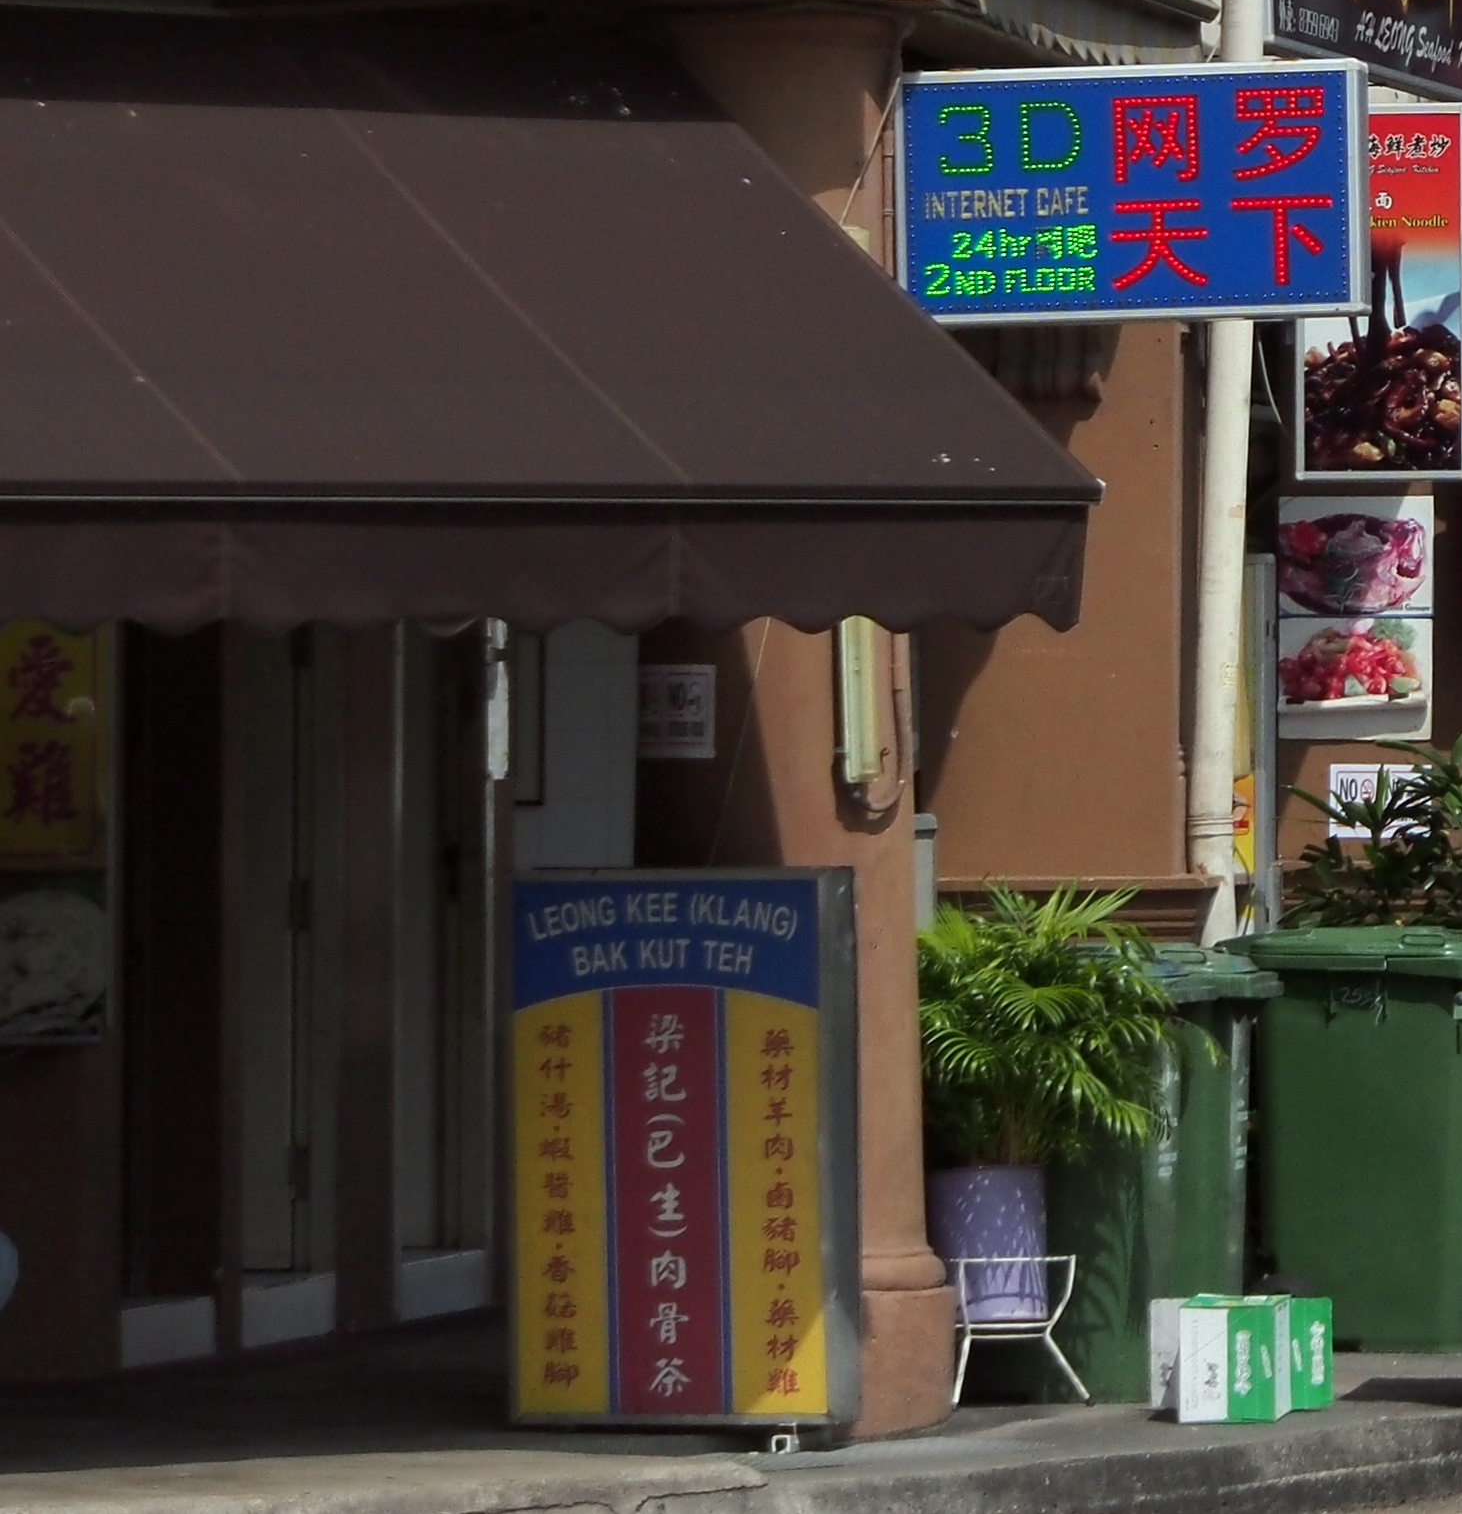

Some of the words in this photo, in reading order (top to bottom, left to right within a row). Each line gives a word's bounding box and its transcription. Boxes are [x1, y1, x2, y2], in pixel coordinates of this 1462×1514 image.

[1416, 27, 1453, 73] Seafood
[939, 101, 1082, 175] 3D
[924, 186, 1029, 220] INTERNET
[1035, 185, 1089, 218] CAFE
[1402, 215, 1449, 228] Noodle
[924, 263, 997, 297] 2ND
[1004, 264, 1097, 293] FLOOR
[528, 894, 617, 943] LEONG
[627, 890, 678, 926] KEE
[690, 891, 799, 943] (KLANG)
[573, 941, 629, 979] BAK
[640, 938, 690, 972] KUT
[703, 939, 754, 977] TEH
